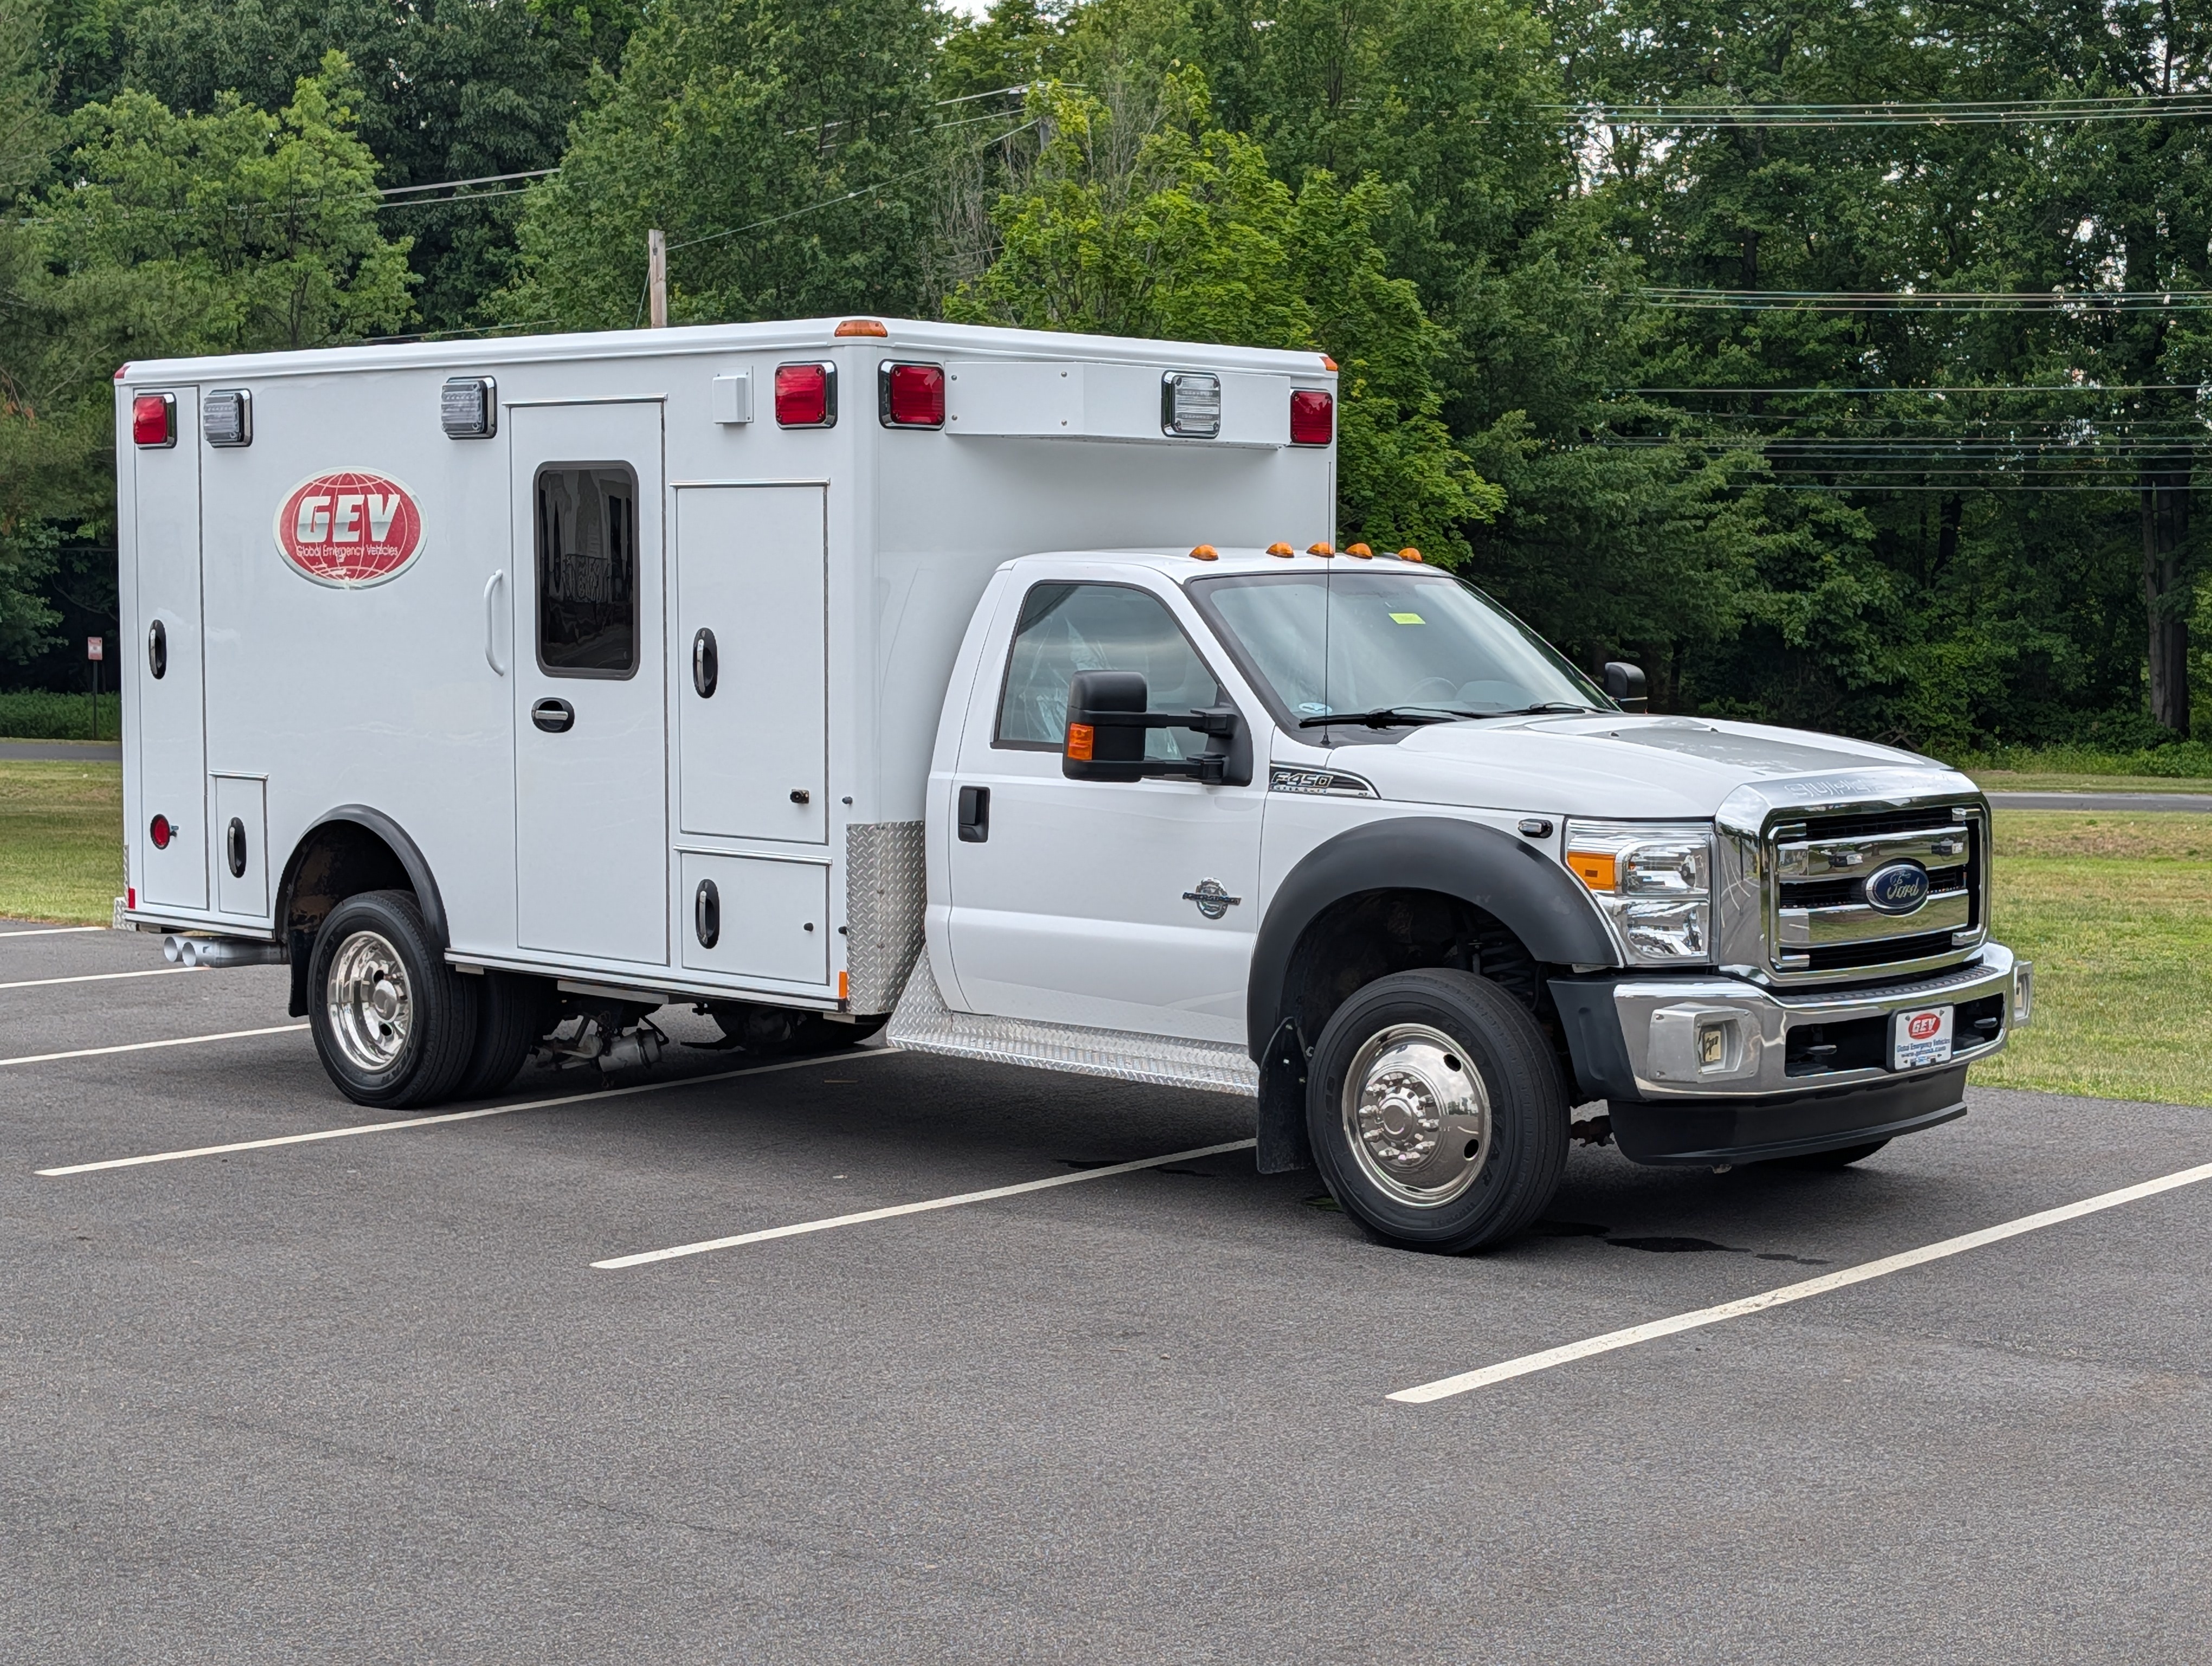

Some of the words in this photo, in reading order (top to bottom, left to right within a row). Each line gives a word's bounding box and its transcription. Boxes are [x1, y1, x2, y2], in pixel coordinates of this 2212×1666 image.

[297, 494, 400, 543] GEV
[297, 545, 321, 556] Global
[323, 544, 364, 562] Emergency
[366, 544, 398, 556] Vehicles
[1887, 870, 1920, 900] Ford
[1912, 1017, 1937, 1034] GEV
